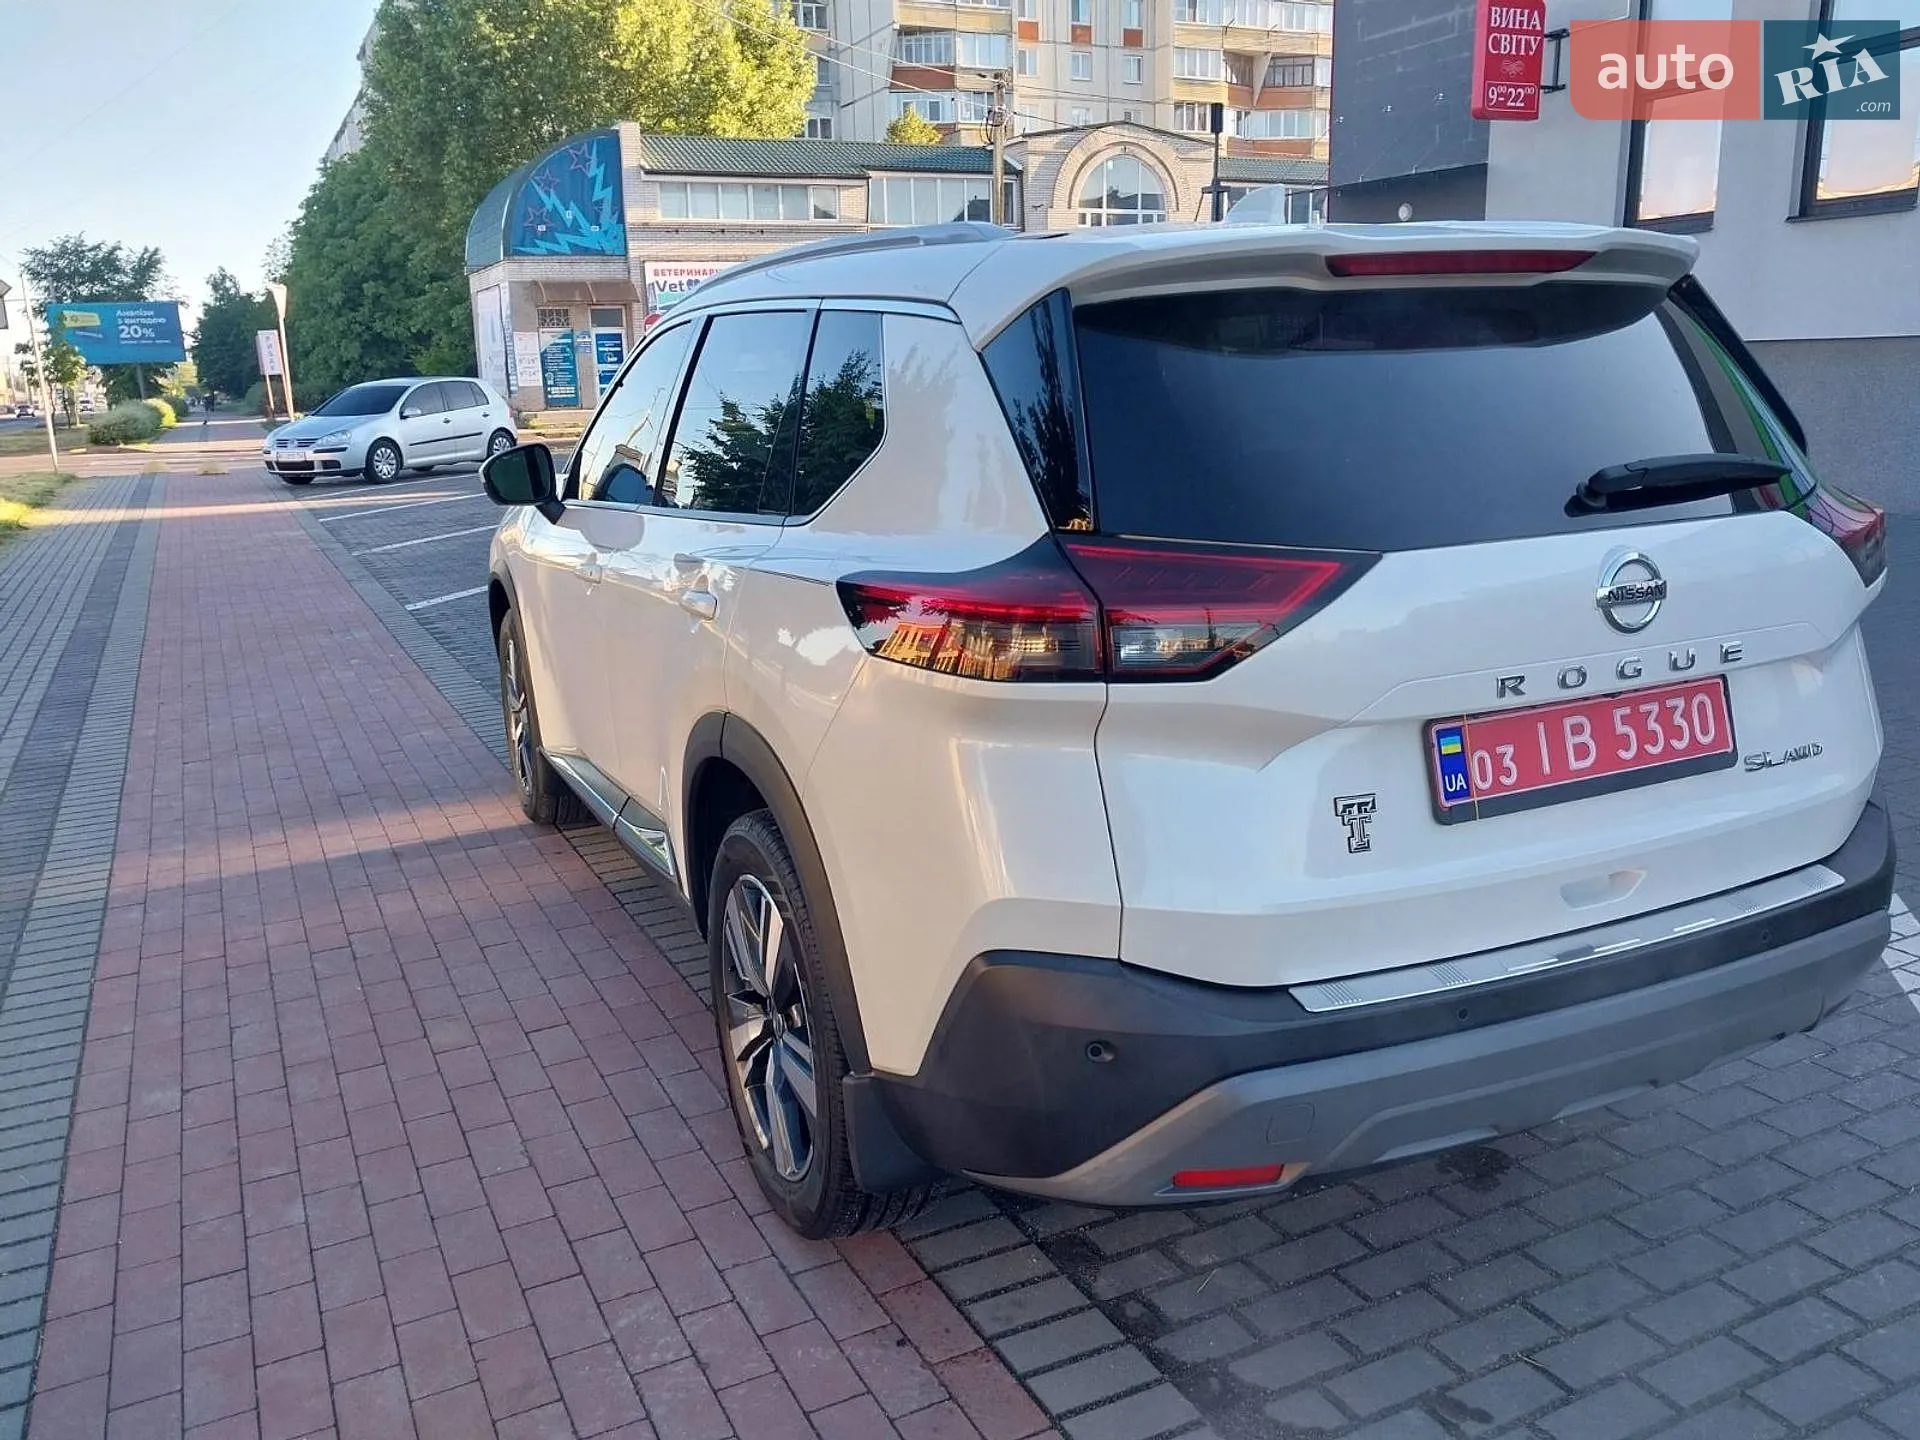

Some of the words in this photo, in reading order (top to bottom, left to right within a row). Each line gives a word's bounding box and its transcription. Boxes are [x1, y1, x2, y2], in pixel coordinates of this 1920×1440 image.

[1490, 7, 1541, 30] ВИНА
[1488, 33, 1541, 55] СВІТУ
[655, 280, 685, 293] Vet
[119, 325, 155, 338] 20%
[1607, 580, 1666, 601] NISSAN
[1496, 640, 1745, 699] ROGUE
[1472, 743, 1518, 790] 03
[1613, 692, 1716, 761] 5330
[1445, 773, 1467, 792] UA
